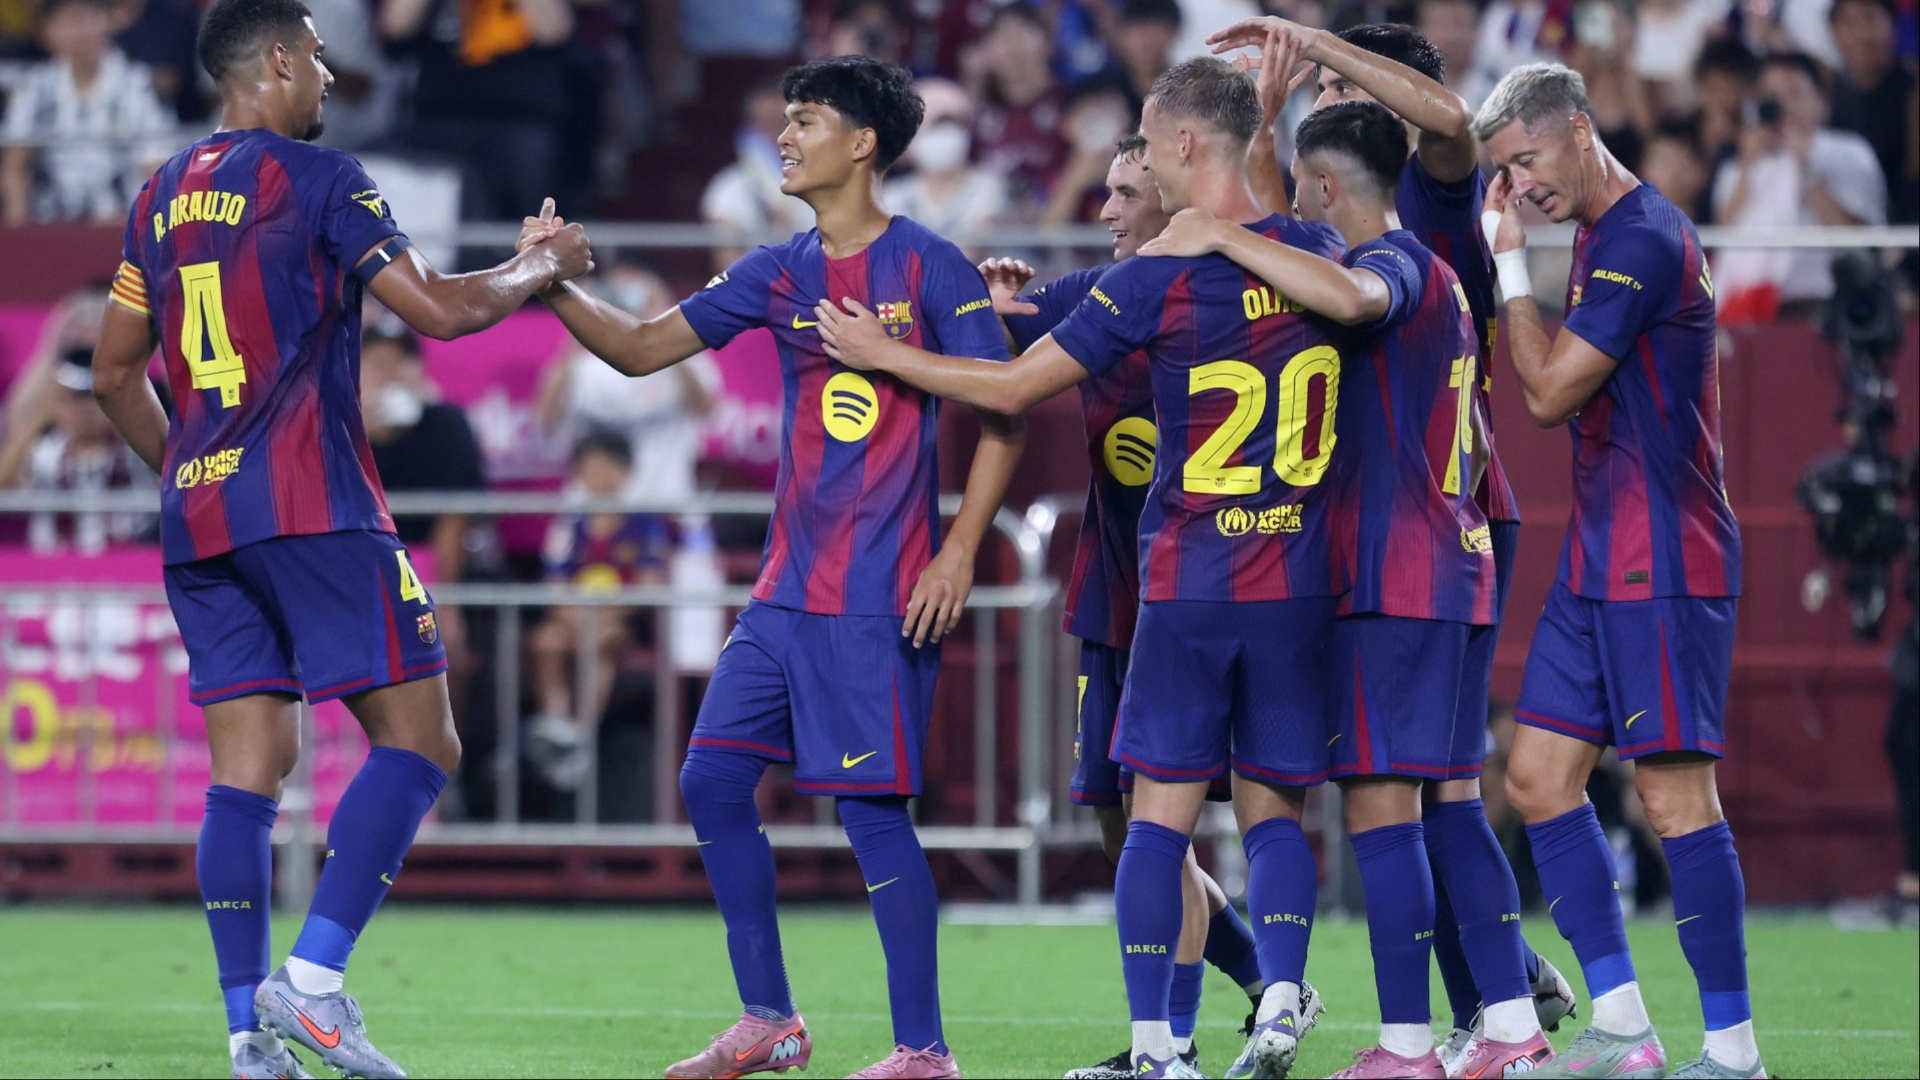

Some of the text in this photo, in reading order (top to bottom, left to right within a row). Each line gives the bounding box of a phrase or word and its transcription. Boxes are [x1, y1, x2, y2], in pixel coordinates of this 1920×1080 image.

[168, 190, 246, 230] ARAUJO
[1090, 285, 1121, 316] LIGHT tv
[1633, 281, 1643, 291] tv
[178, 261, 247, 408] 4
[1183, 345, 1341, 495] 20
[395, 549, 428, 605] 4
[1263, 913, 1308, 928] BARÇA
[1126, 944, 1167, 955] BARÇA
